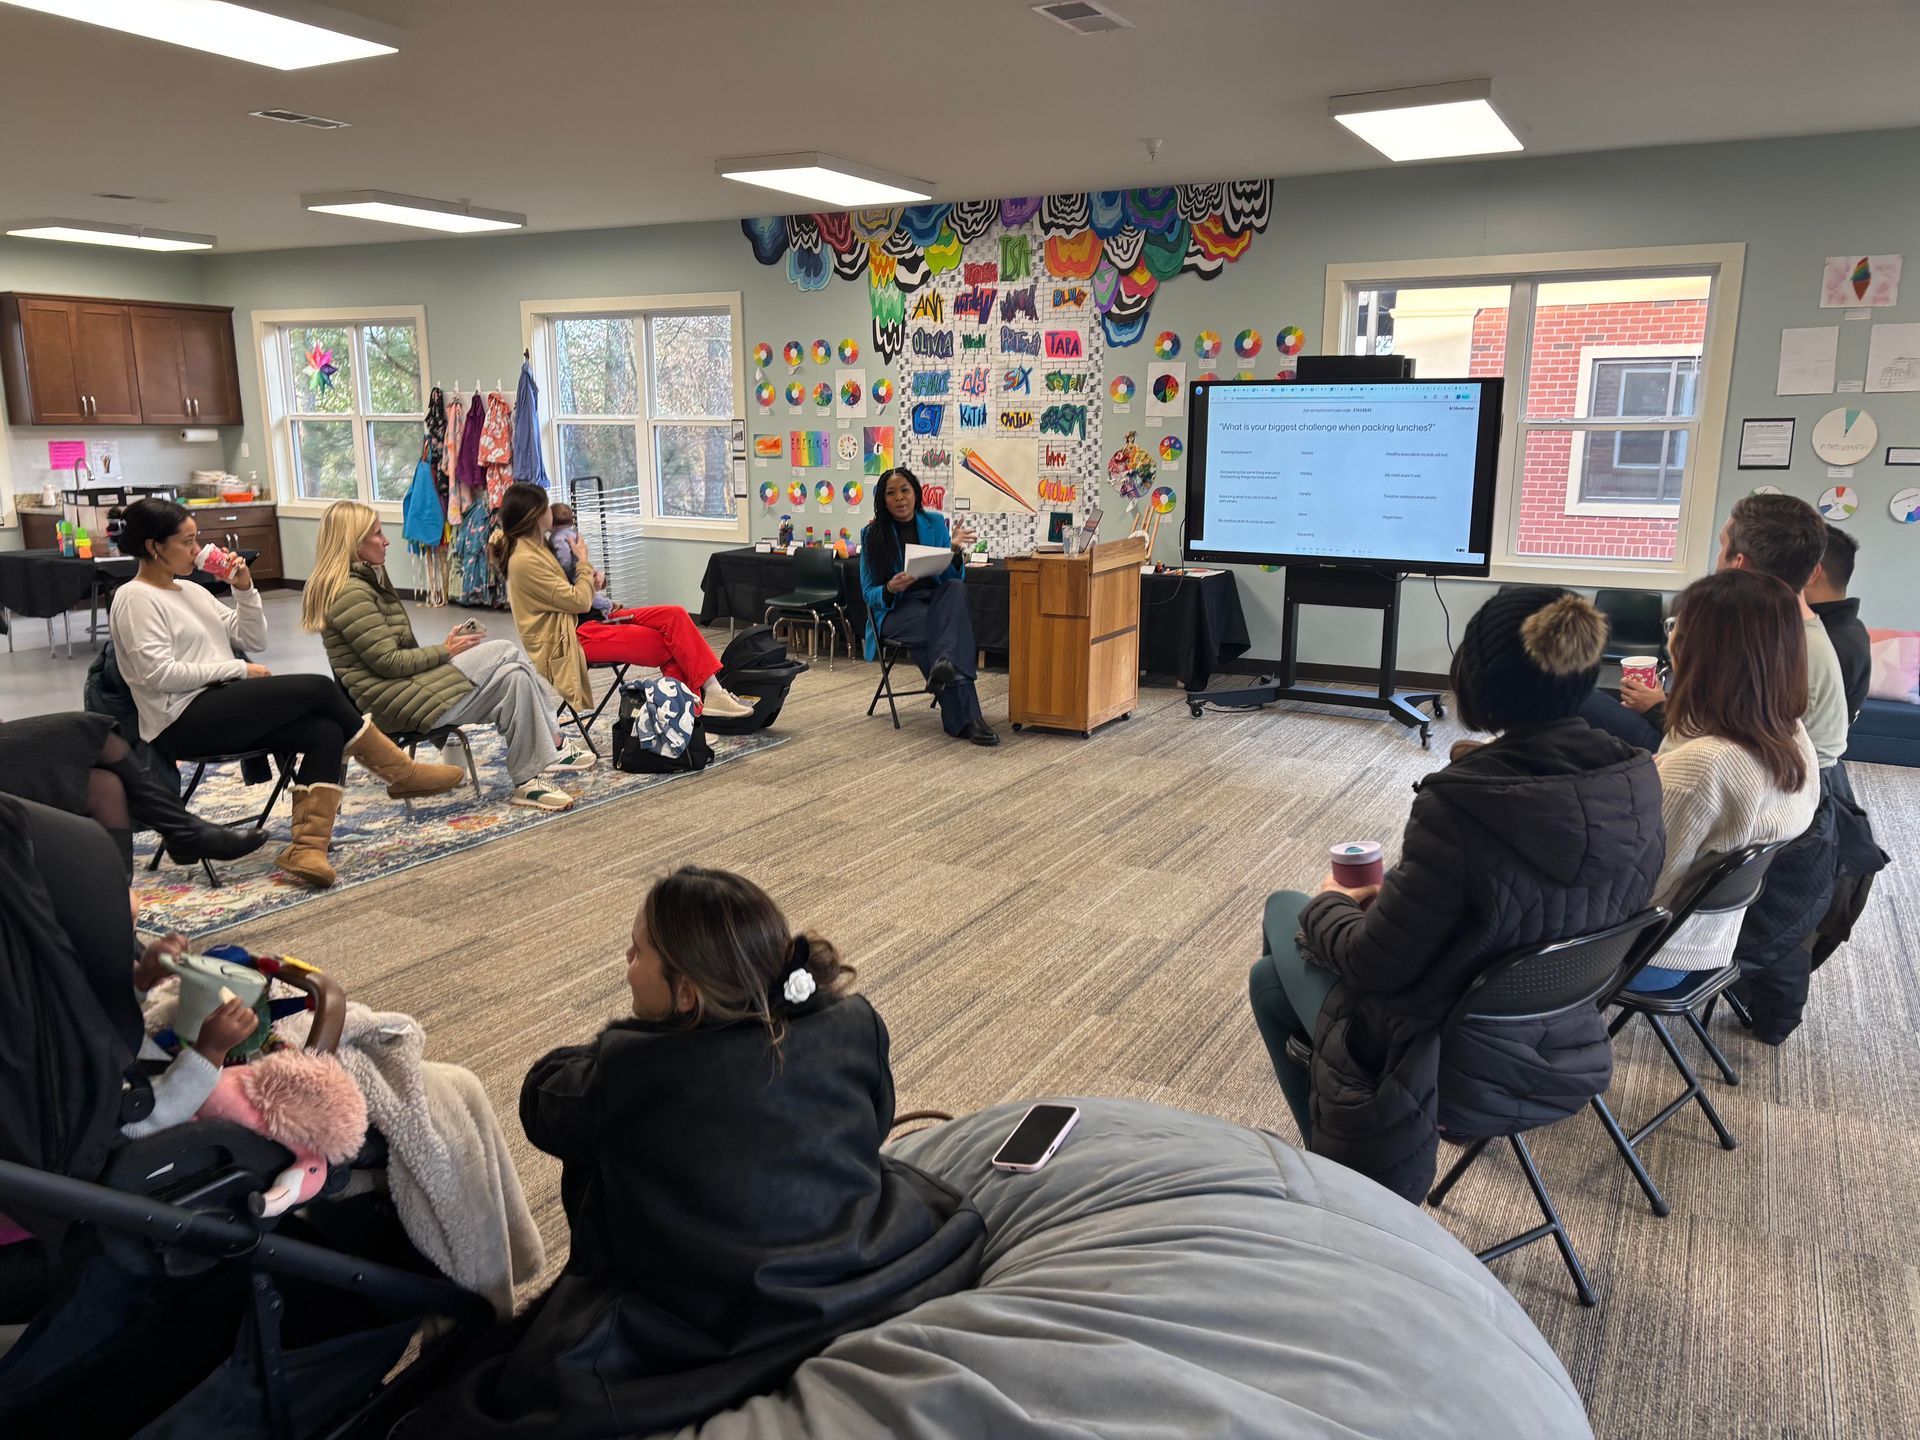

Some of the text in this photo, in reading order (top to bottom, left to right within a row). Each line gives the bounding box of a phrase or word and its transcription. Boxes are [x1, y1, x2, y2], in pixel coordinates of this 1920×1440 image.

[912, 326, 954, 359] OLIVIA
[1243, 423, 1250, 431] is
[1250, 425, 1267, 433] your
[1268, 423, 1297, 433] biggest
[1298, 423, 1337, 433] challenge
[1338, 424, 1361, 432] when
[1361, 424, 1395, 433] packing
